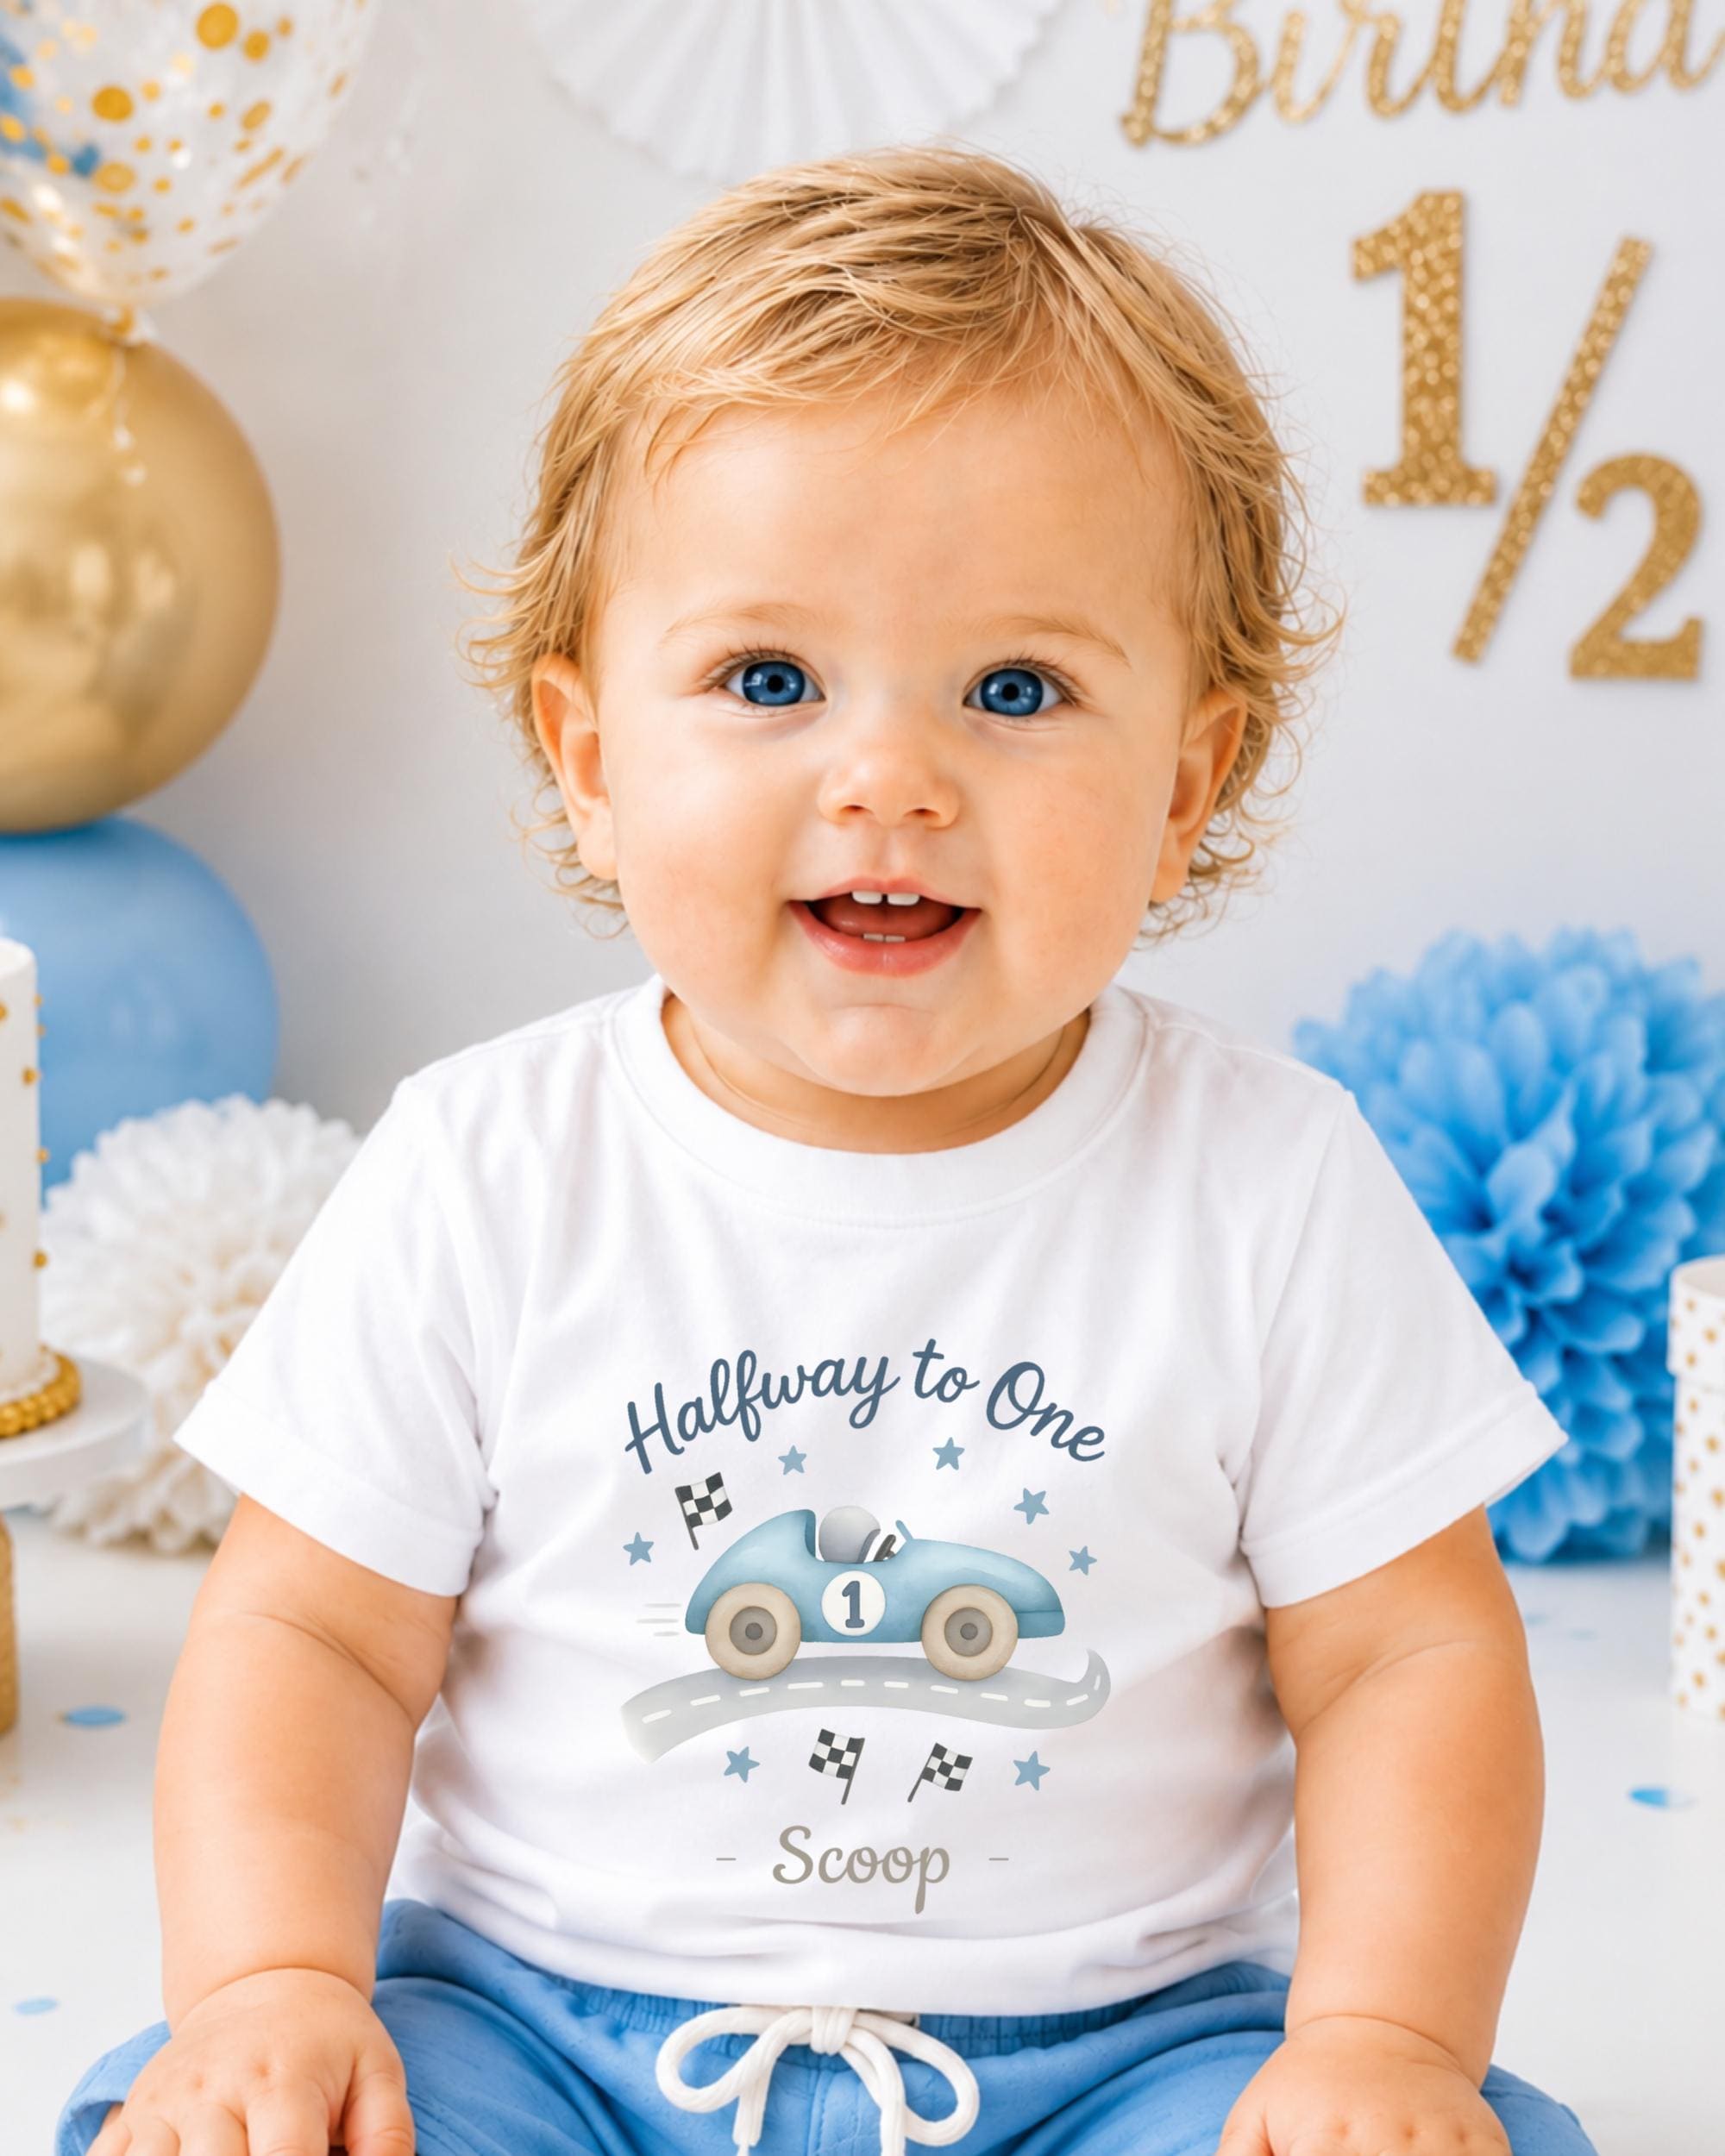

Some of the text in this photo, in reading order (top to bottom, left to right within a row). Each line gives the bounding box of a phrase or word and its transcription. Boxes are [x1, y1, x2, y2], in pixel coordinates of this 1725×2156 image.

[624, 1338, 1107, 1475] Halfway to One
[841, 1580, 866, 1629] 1
[772, 1825, 950, 1915] Scoop
